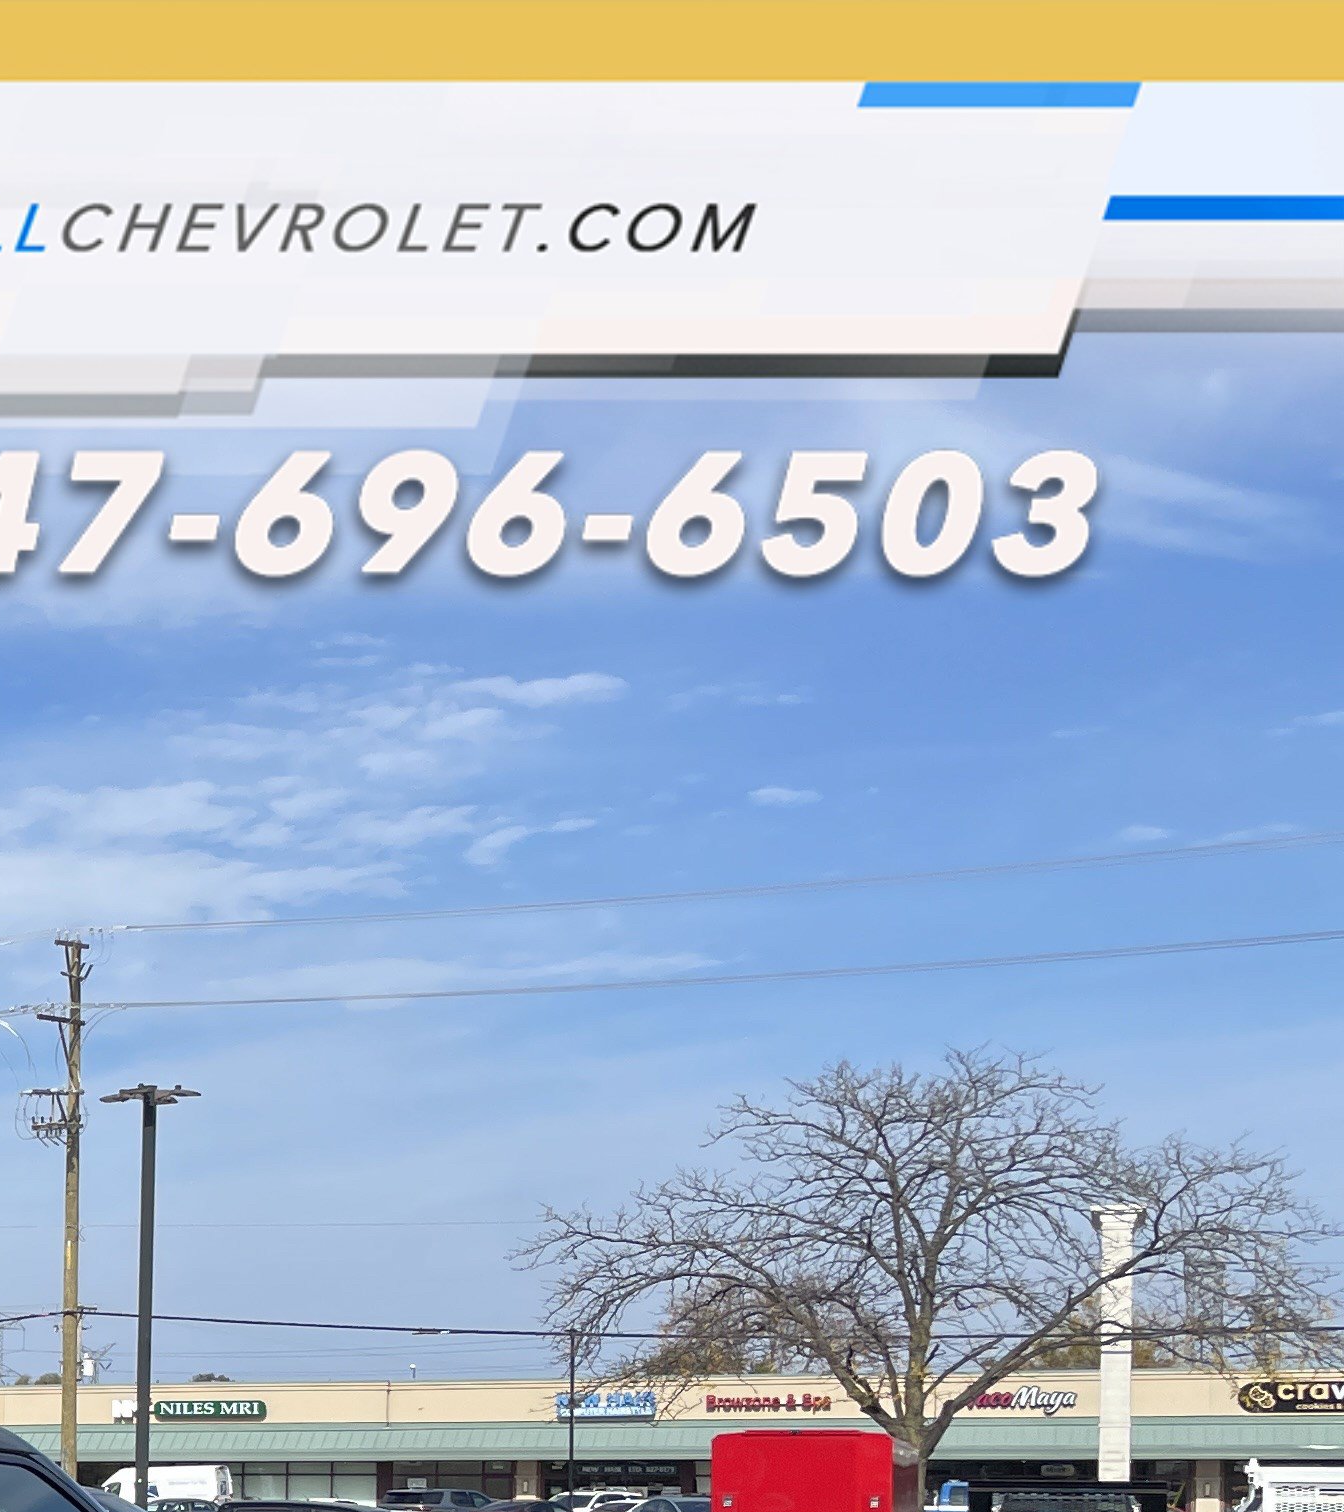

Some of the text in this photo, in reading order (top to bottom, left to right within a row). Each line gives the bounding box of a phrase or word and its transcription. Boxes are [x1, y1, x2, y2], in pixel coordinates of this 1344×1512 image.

[159, 1402, 215, 1415] NILES
[220, 1402, 260, 1415] MRI
[967, 1386, 1077, 1415] acoMaya
